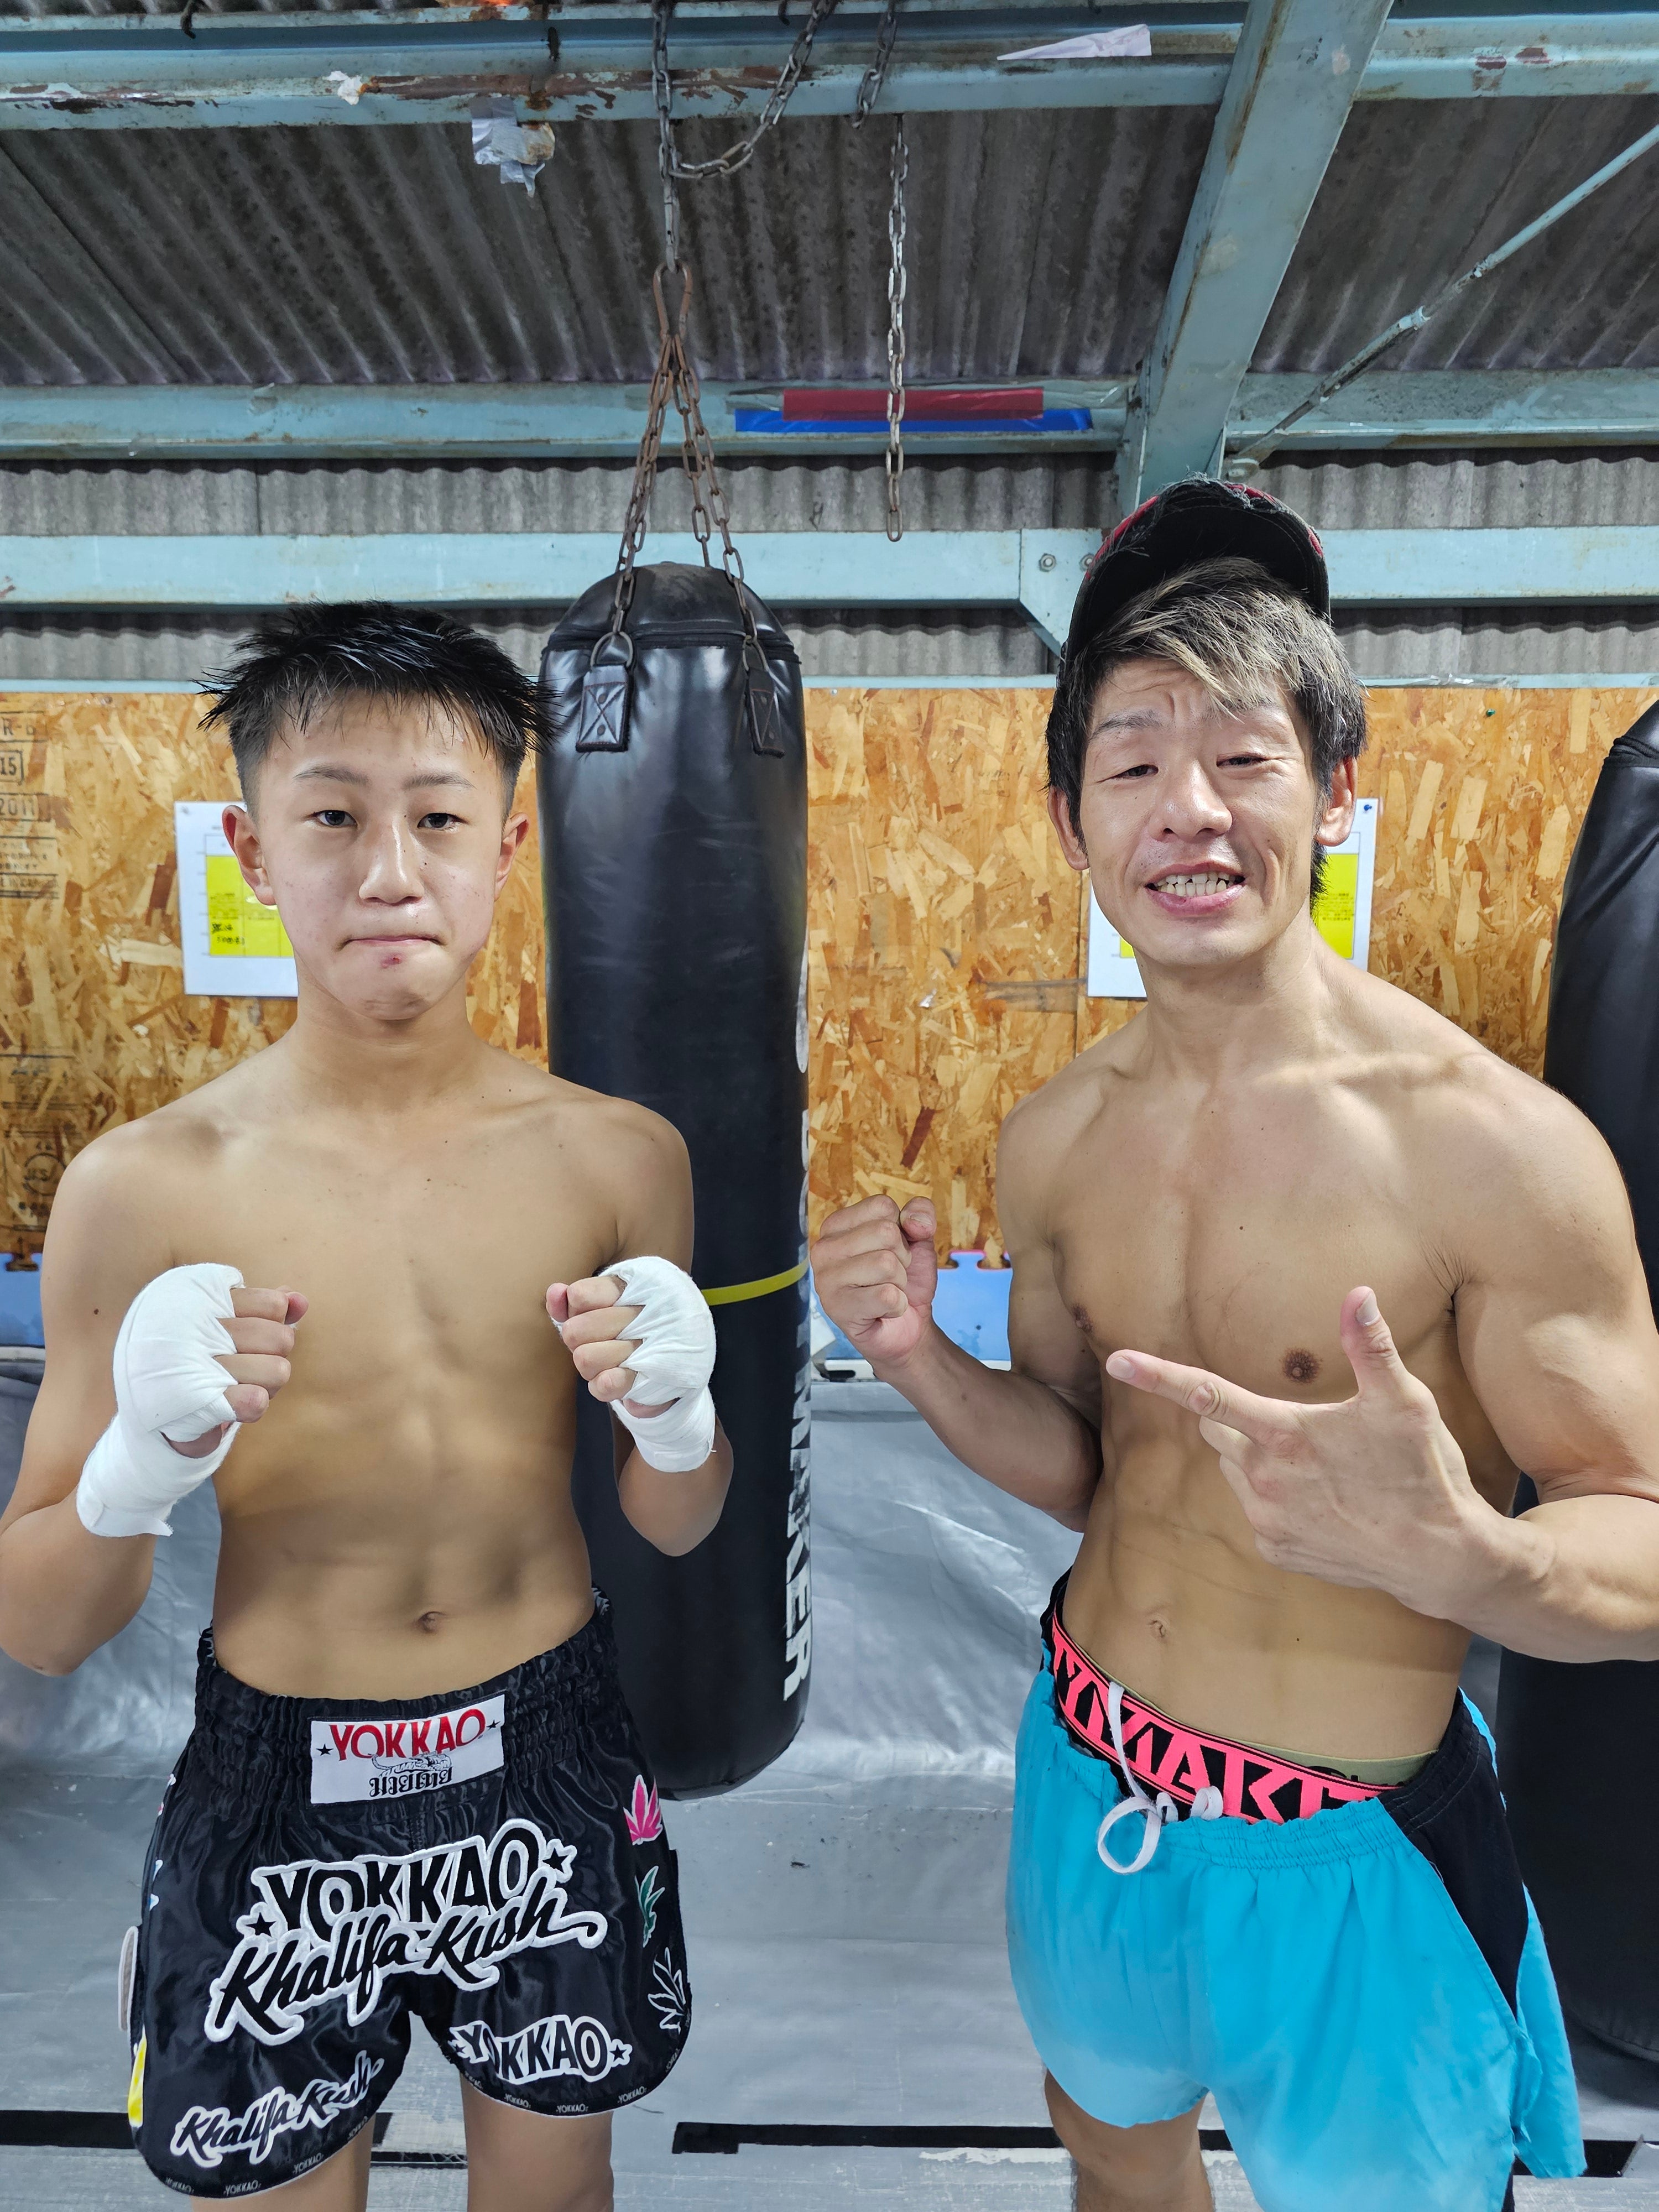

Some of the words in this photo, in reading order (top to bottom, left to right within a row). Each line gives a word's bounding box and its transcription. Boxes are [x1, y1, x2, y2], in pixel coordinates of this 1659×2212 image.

[328, 1708, 486, 1762] YOKKAO
[259, 1822, 545, 1939] YOKKAO
[209, 1908, 421, 2039] Khalifa
[424, 1871, 603, 1987] Kush
[173, 2088, 300, 2164] Khalifa
[556, 2103, 586, 2113] YOKKAO
[225, 2179, 259, 2196] YOKKAO
